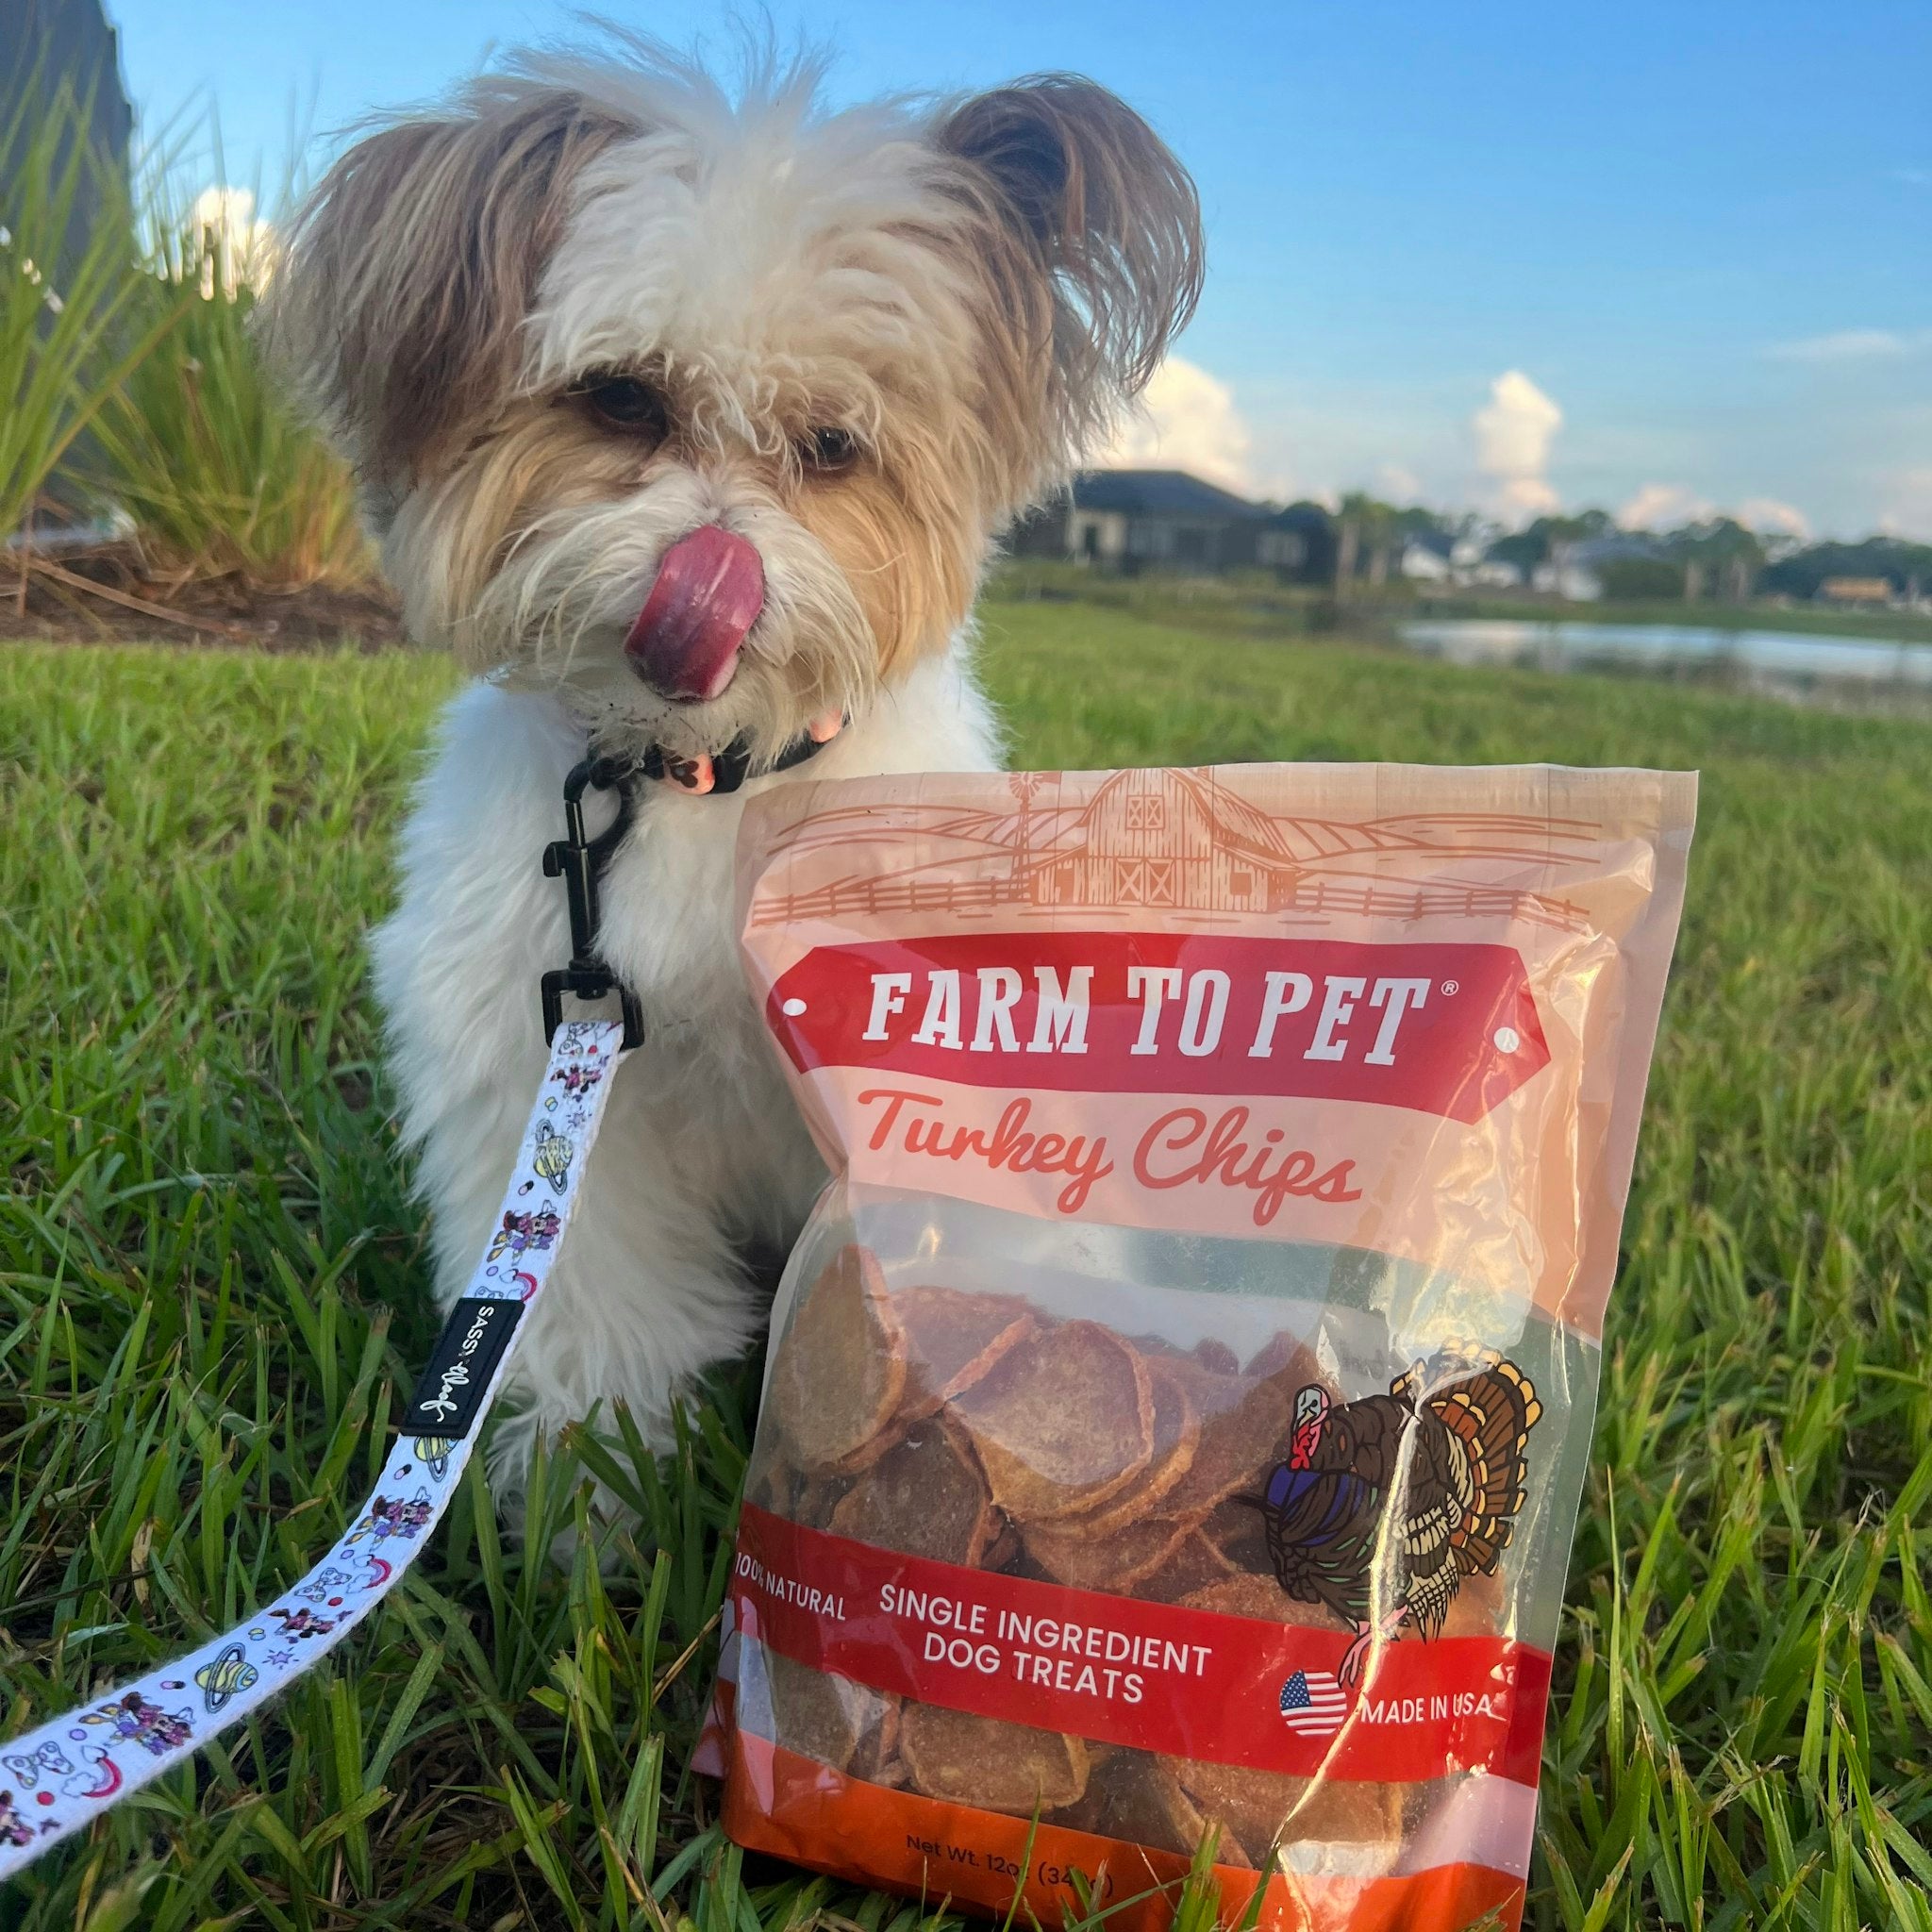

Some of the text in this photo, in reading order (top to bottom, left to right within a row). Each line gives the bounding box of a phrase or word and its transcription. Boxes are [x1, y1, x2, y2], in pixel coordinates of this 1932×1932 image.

[862, 965, 1094, 1054] FARM
[1126, 966, 1231, 1058] TO
[1248, 971, 1430, 1067] PET
[858, 1089, 1362, 1226] Turkey Chips
[766, 1571, 846, 1621] NATURAL
[879, 1582, 1213, 1676] SINGLE INGREDIENT
[924, 1630, 1144, 1704] DOG TREATS
[1360, 1692, 1493, 1724] MADE IN USA
[907, 1834, 941, 1857] Net
[947, 1845, 979, 1867] Wt.
[1039, 1861, 1113, 1899] (34)
